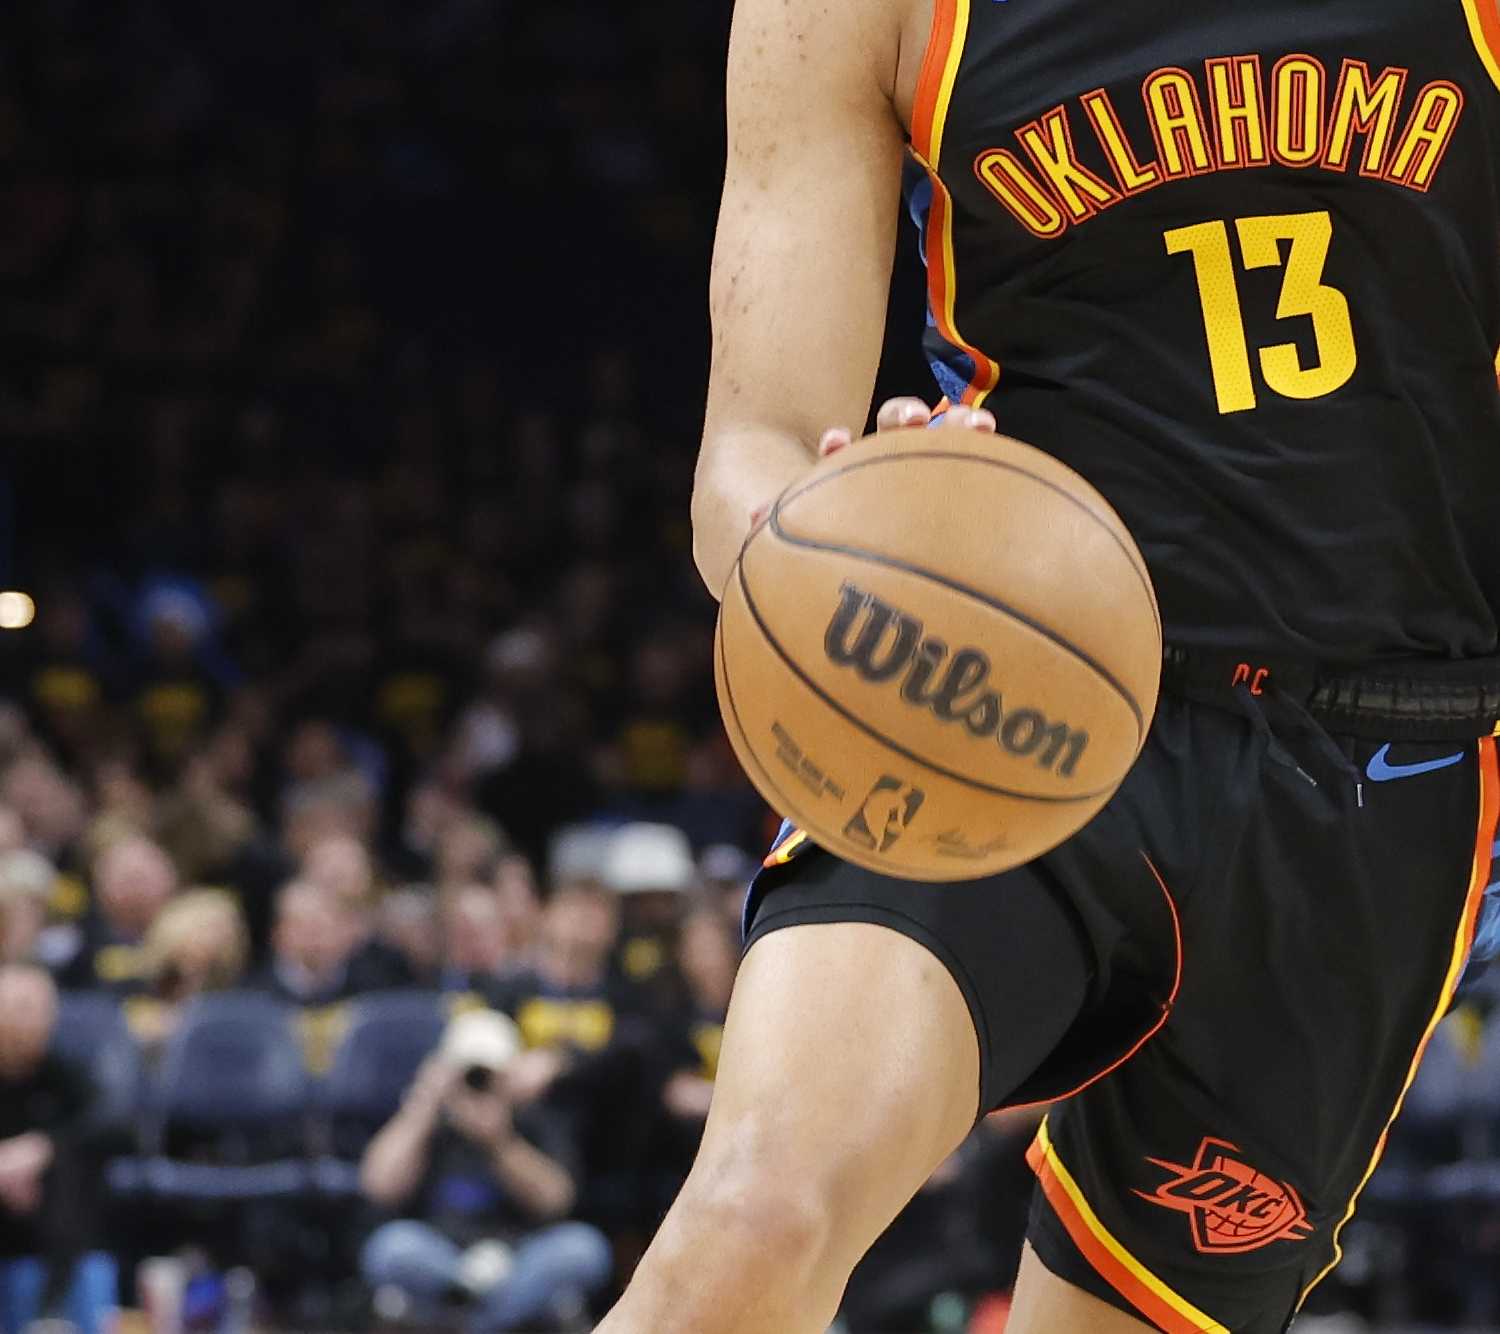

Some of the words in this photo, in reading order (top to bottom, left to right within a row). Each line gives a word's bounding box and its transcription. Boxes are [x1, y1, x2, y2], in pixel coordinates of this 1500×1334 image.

[973, 53, 1465, 240] OKLAHOMA
[1162, 210, 1358, 416] 13
[823, 577, 1091, 780] Wilson
